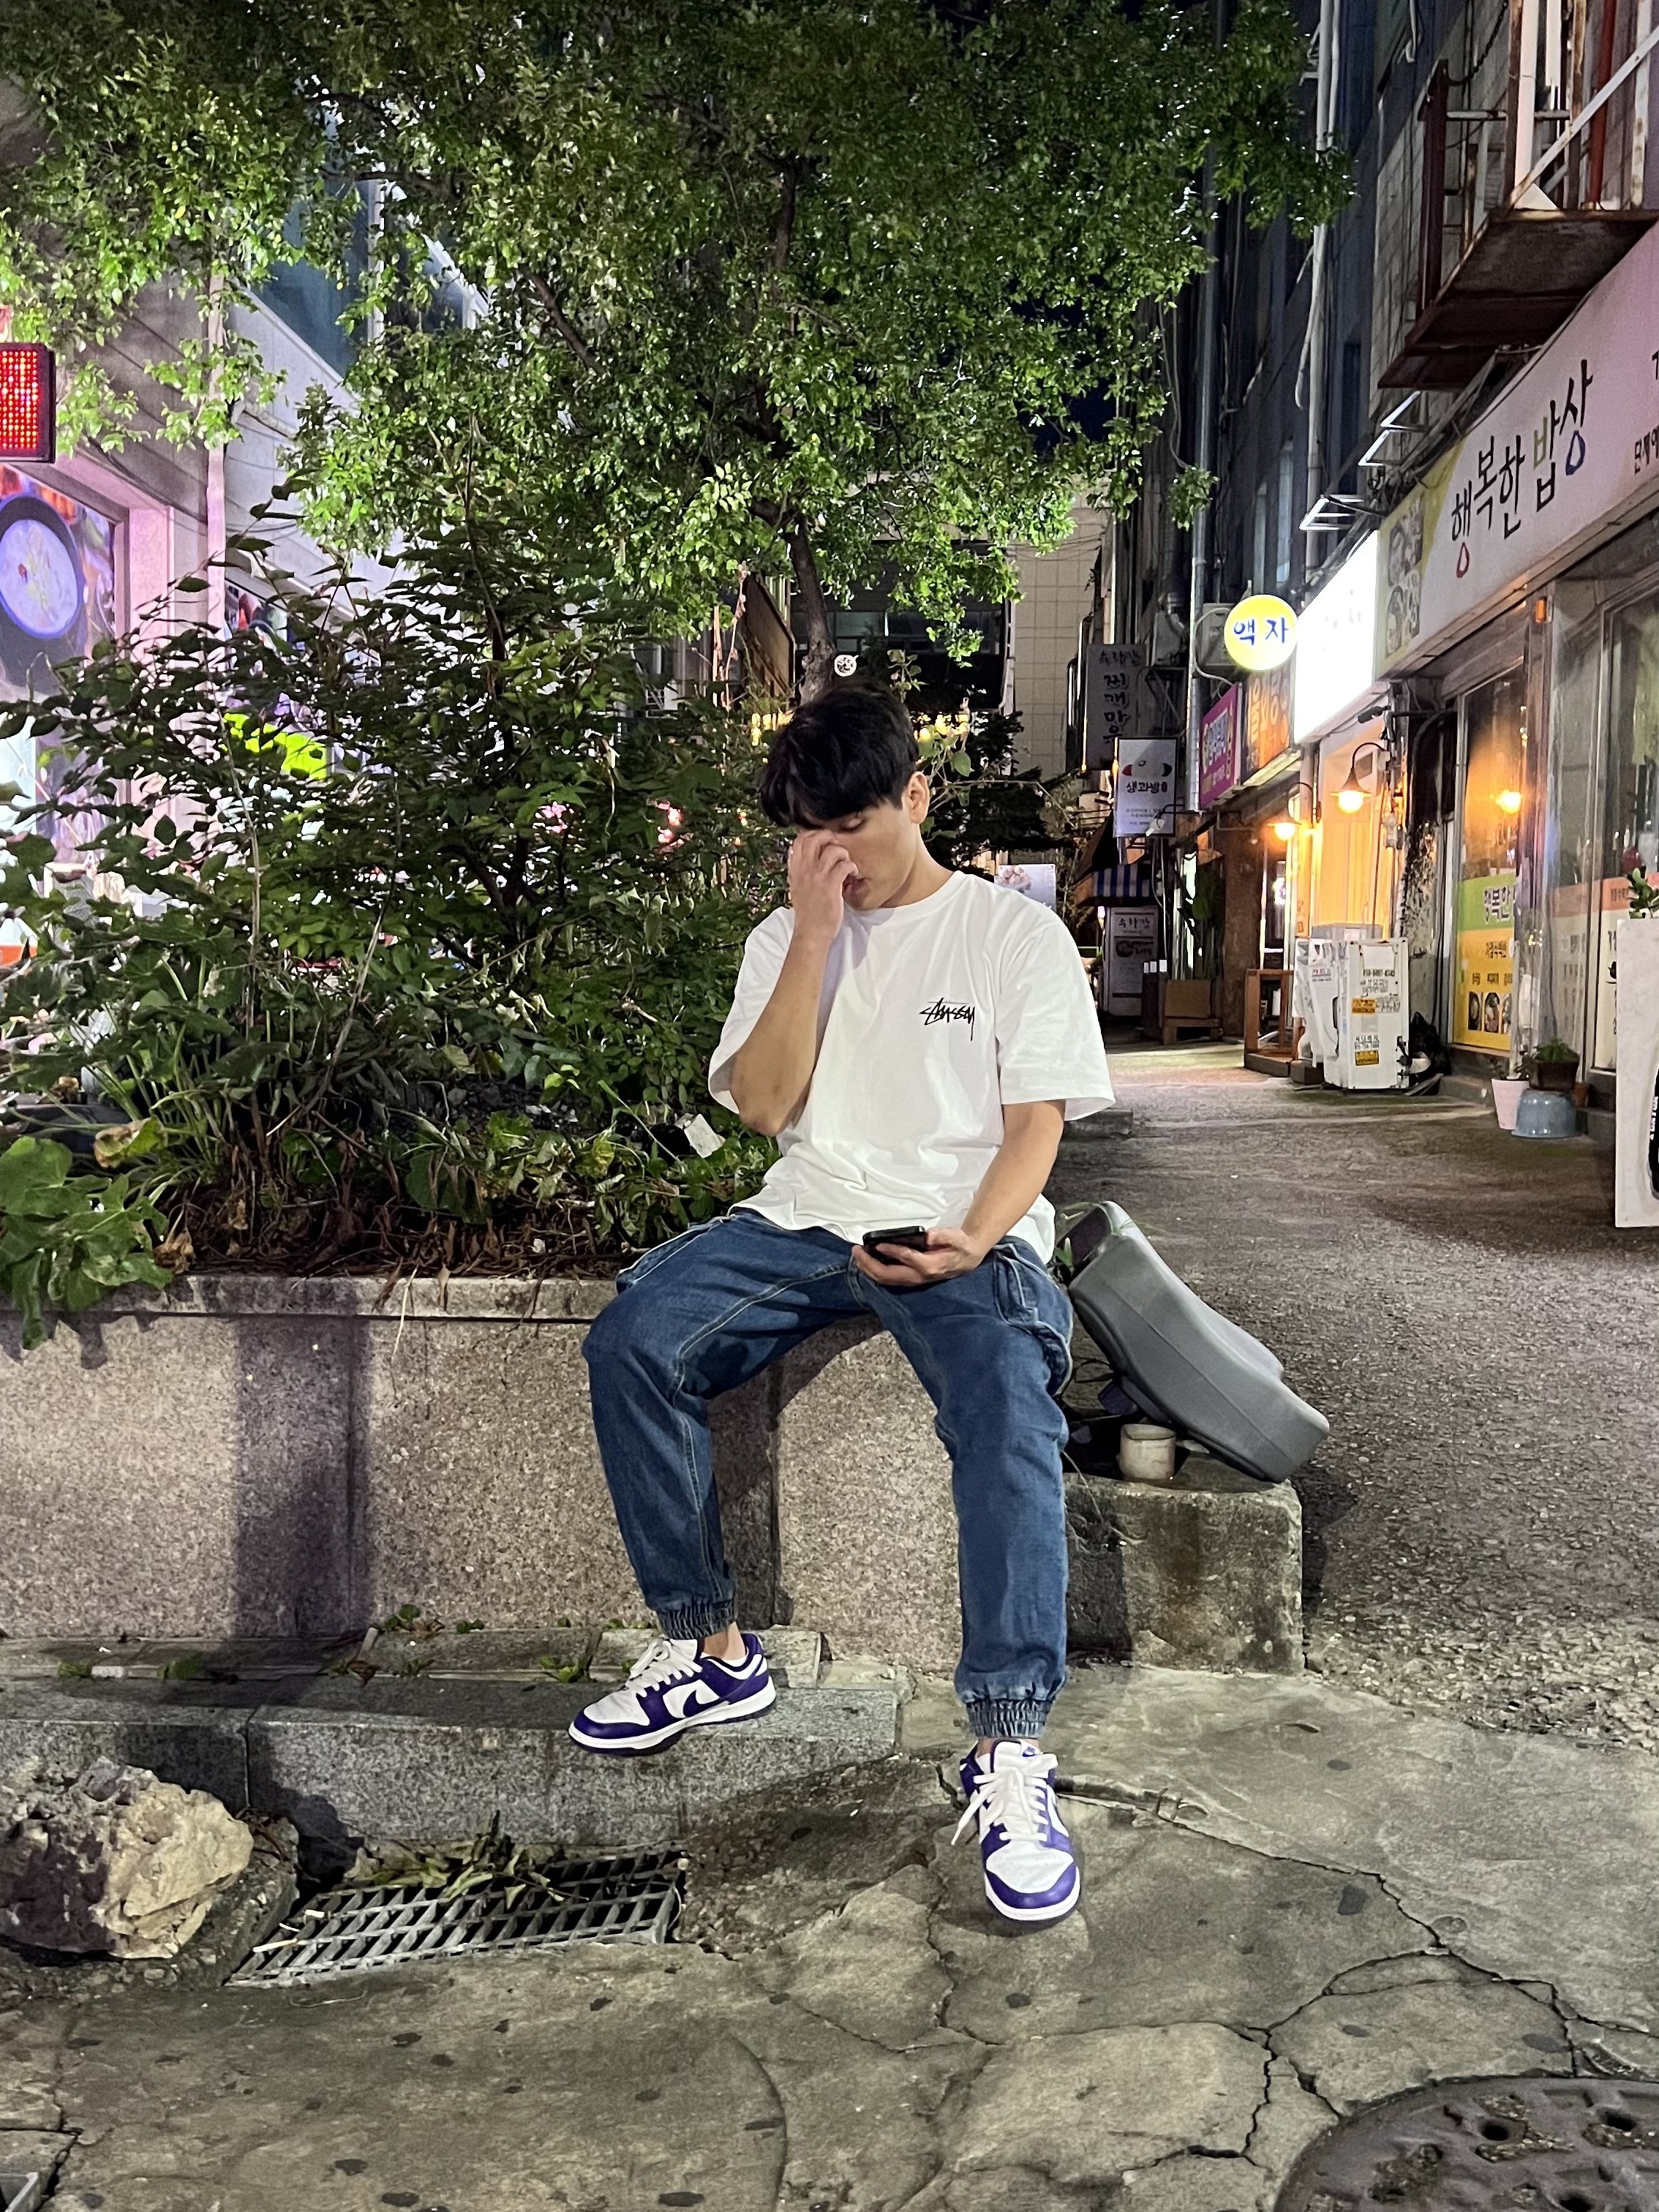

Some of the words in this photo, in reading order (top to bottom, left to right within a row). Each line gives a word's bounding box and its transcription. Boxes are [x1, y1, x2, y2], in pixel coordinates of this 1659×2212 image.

[1451, 435, 1525, 578] 행복한
[1534, 359, 1593, 512] 밥상
[1126, 780, 1160, 794] 생과방
[1484, 887, 1511, 922] 행복한
